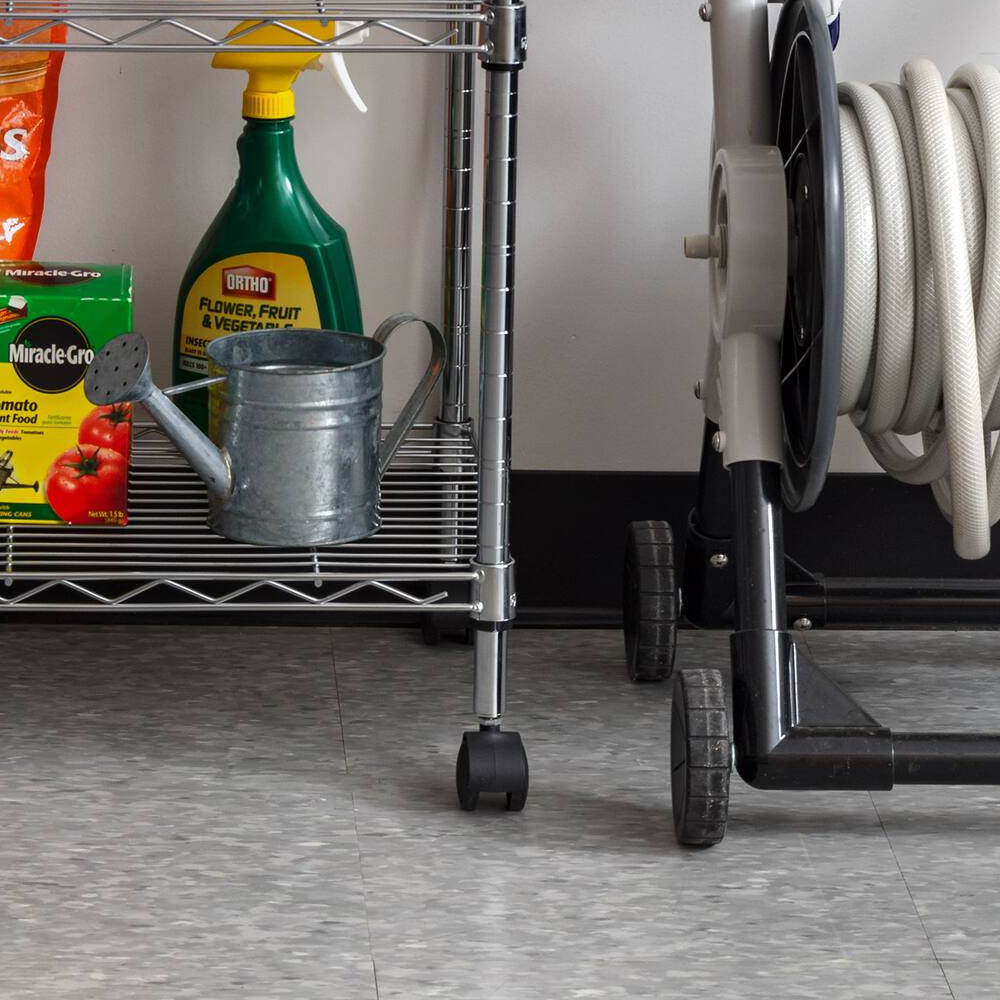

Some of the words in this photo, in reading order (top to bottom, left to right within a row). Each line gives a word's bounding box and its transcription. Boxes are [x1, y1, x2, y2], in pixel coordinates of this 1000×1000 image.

[226, 273, 269, 294] ORTHO
[198, 296, 257, 319] FLOWER,
[258, 303, 302, 320] FRUIT
[201, 313, 211, 329] &
[185, 335, 211, 348] INSEC
[12, 413, 39, 424] Food
